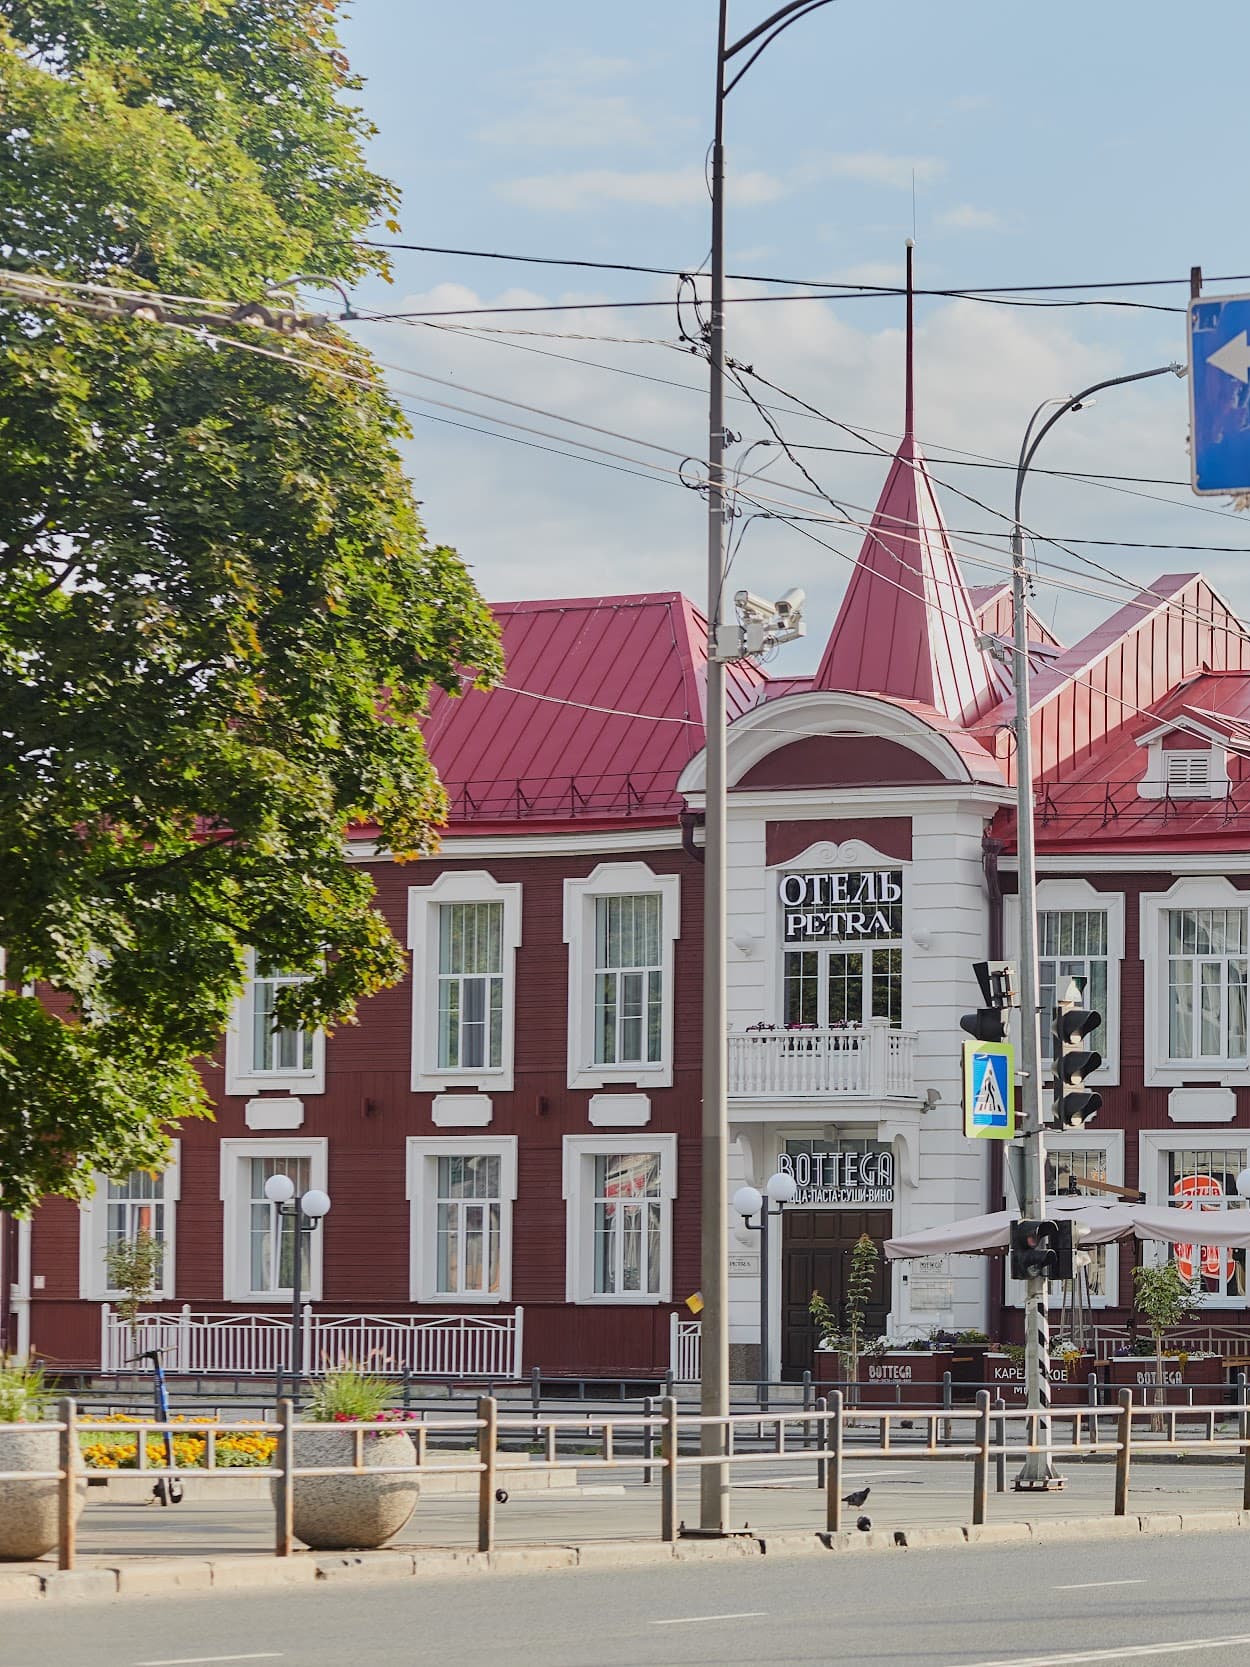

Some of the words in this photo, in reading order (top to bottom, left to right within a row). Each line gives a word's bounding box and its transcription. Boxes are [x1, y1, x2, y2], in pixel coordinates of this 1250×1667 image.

[779, 871, 901, 906] ОТЕЛЬ
[786, 912, 892, 936] PETRA
[778, 1152, 893, 1187] BOTTEGA
[869, 1365, 912, 1379] BOTTEGA
[994, 1367, 1068, 1381] КАРЕКОЕ
[1136, 1371, 1183, 1385] BOTEGA
